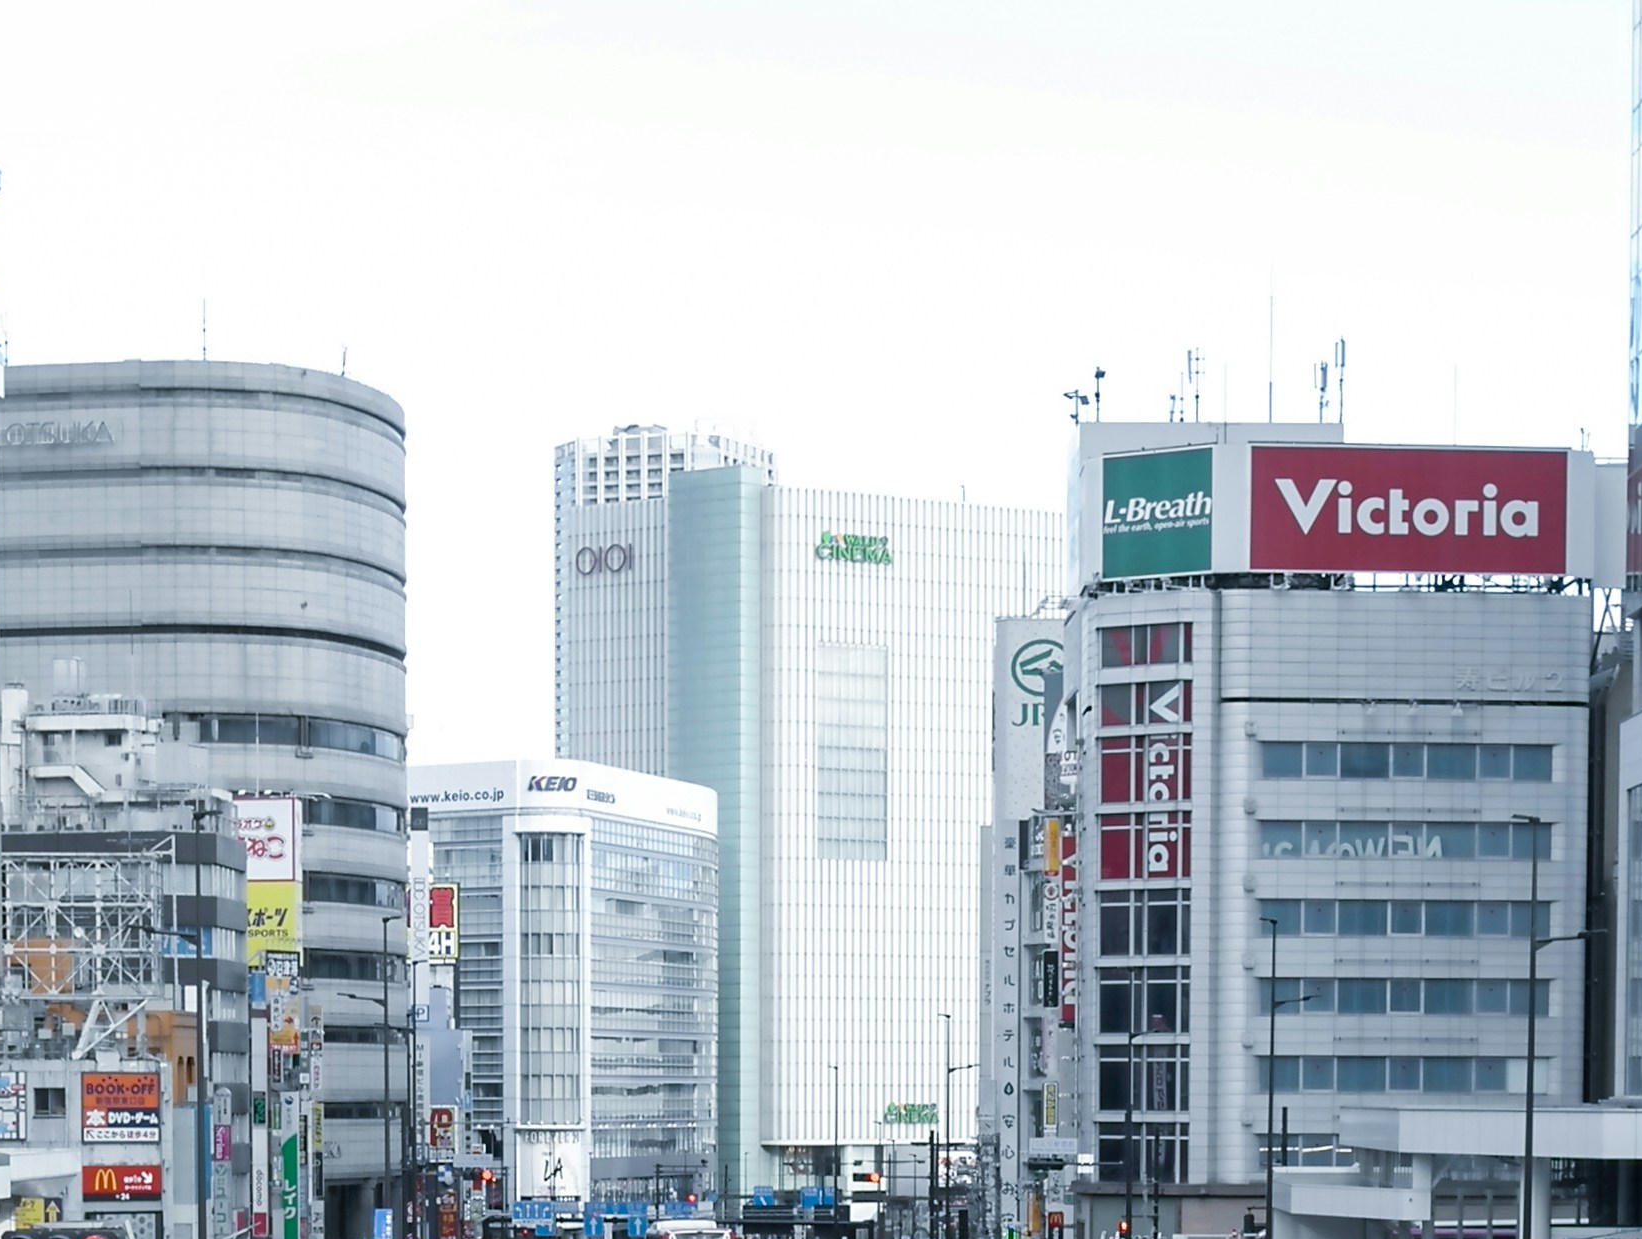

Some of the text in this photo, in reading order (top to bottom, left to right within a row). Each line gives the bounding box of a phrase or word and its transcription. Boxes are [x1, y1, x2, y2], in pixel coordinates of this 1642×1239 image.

[1104, 491, 1211, 524] L-Breath
[1275, 478, 1539, 537] Victoria
[1118, 524, 1129, 533] the
[528, 776, 577, 793] KEIO
[409, 788, 504, 804] www.keio.co.jp
[238, 836, 284, 858] ねこ
[248, 929, 289, 938] SPORTS
[86, 1109, 105, 1126] 本
[284, 1179, 297, 1219] レイク
